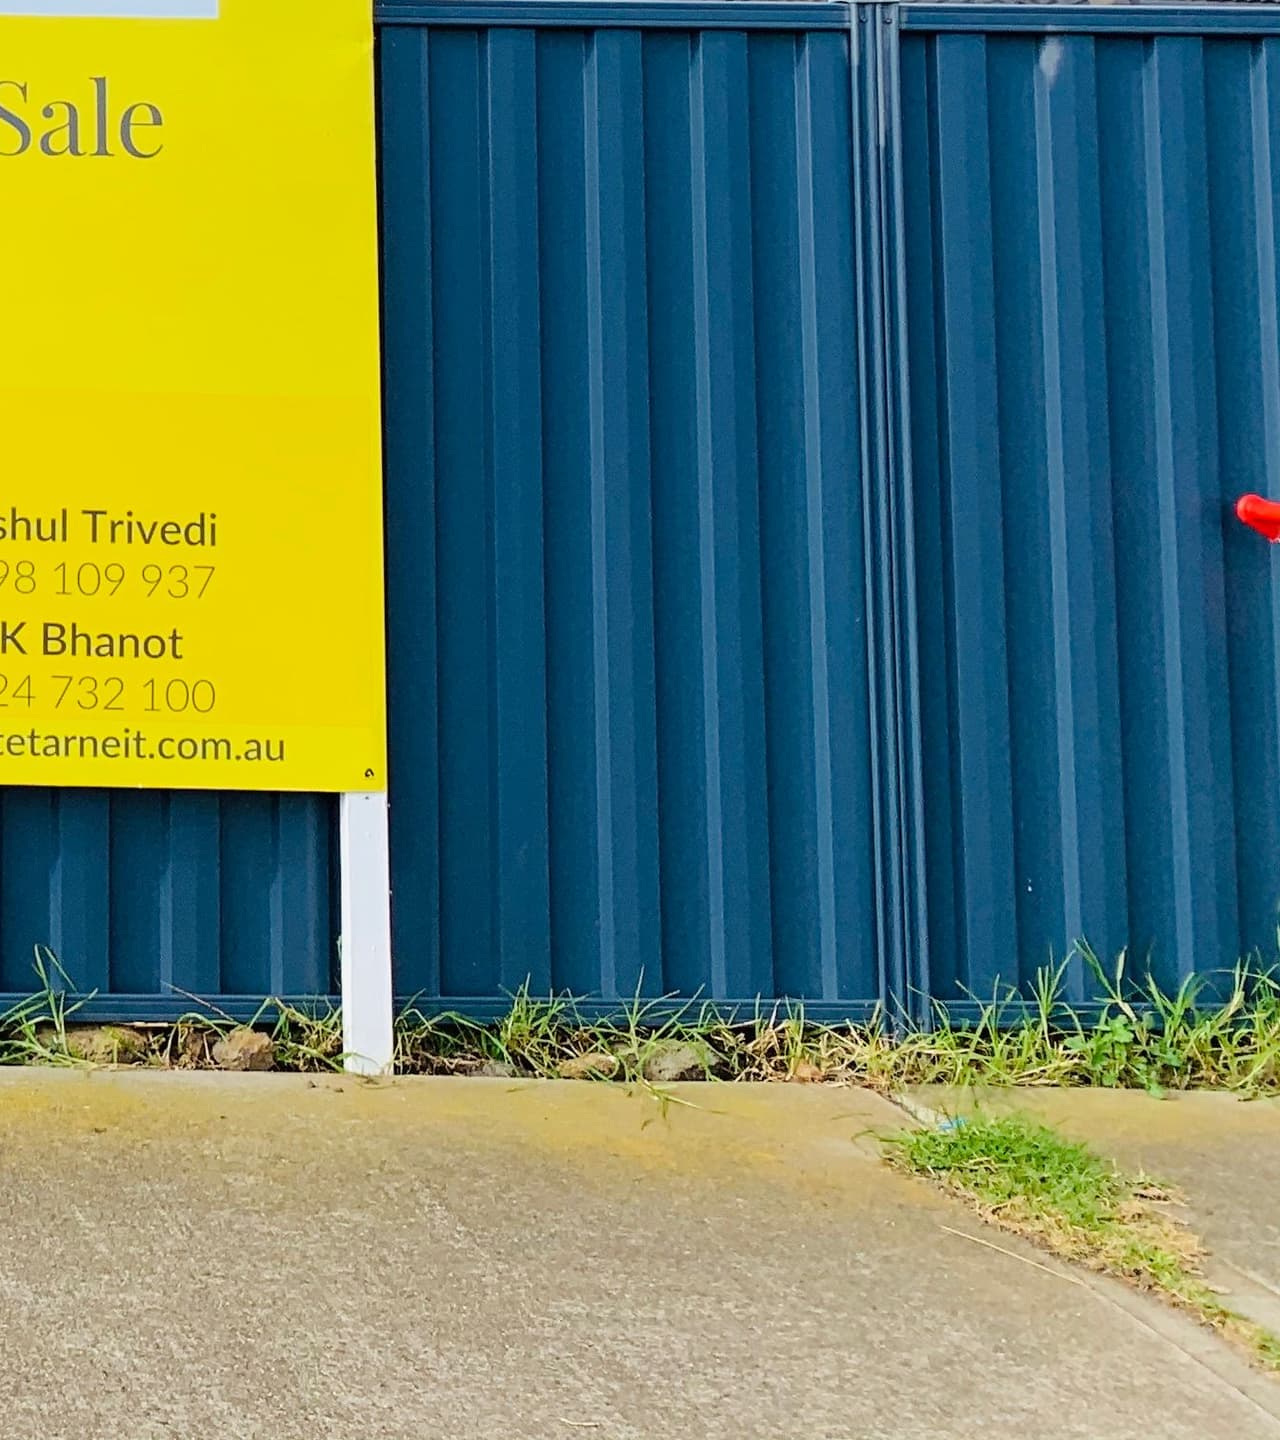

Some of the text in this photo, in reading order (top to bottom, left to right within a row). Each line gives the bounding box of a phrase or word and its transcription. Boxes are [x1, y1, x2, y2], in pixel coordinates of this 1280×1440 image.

[81, 509, 217, 547] Trivedi
[53, 561, 126, 597] 109
[141, 563, 216, 599] 937
[42, 621, 184, 660] Bhanot
[50, 674, 125, 711] 732
[142, 677, 216, 714] 100
